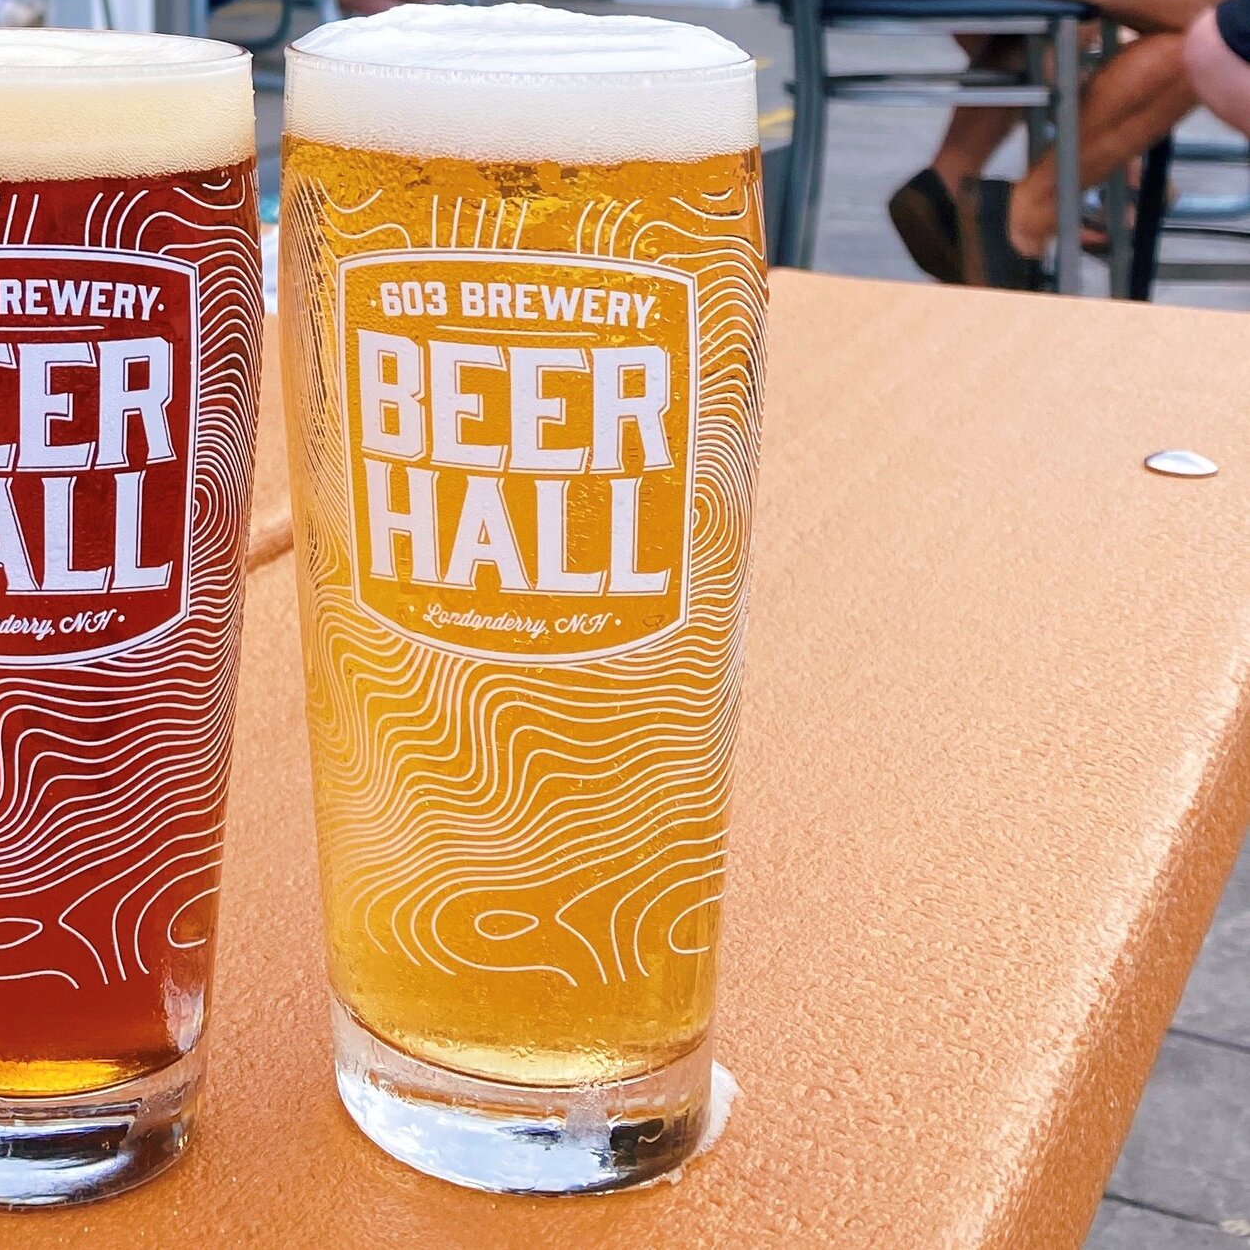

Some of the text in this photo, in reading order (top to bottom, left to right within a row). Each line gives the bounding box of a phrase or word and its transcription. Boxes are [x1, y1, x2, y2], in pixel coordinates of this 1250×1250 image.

[381, 282, 654, 328] 603 BREWERY
[357, 329, 674, 473] BEER
[363, 459, 670, 596] HALL
[61, 609, 116, 633] NH
[425, 604, 608, 638] Londonderry, NH
